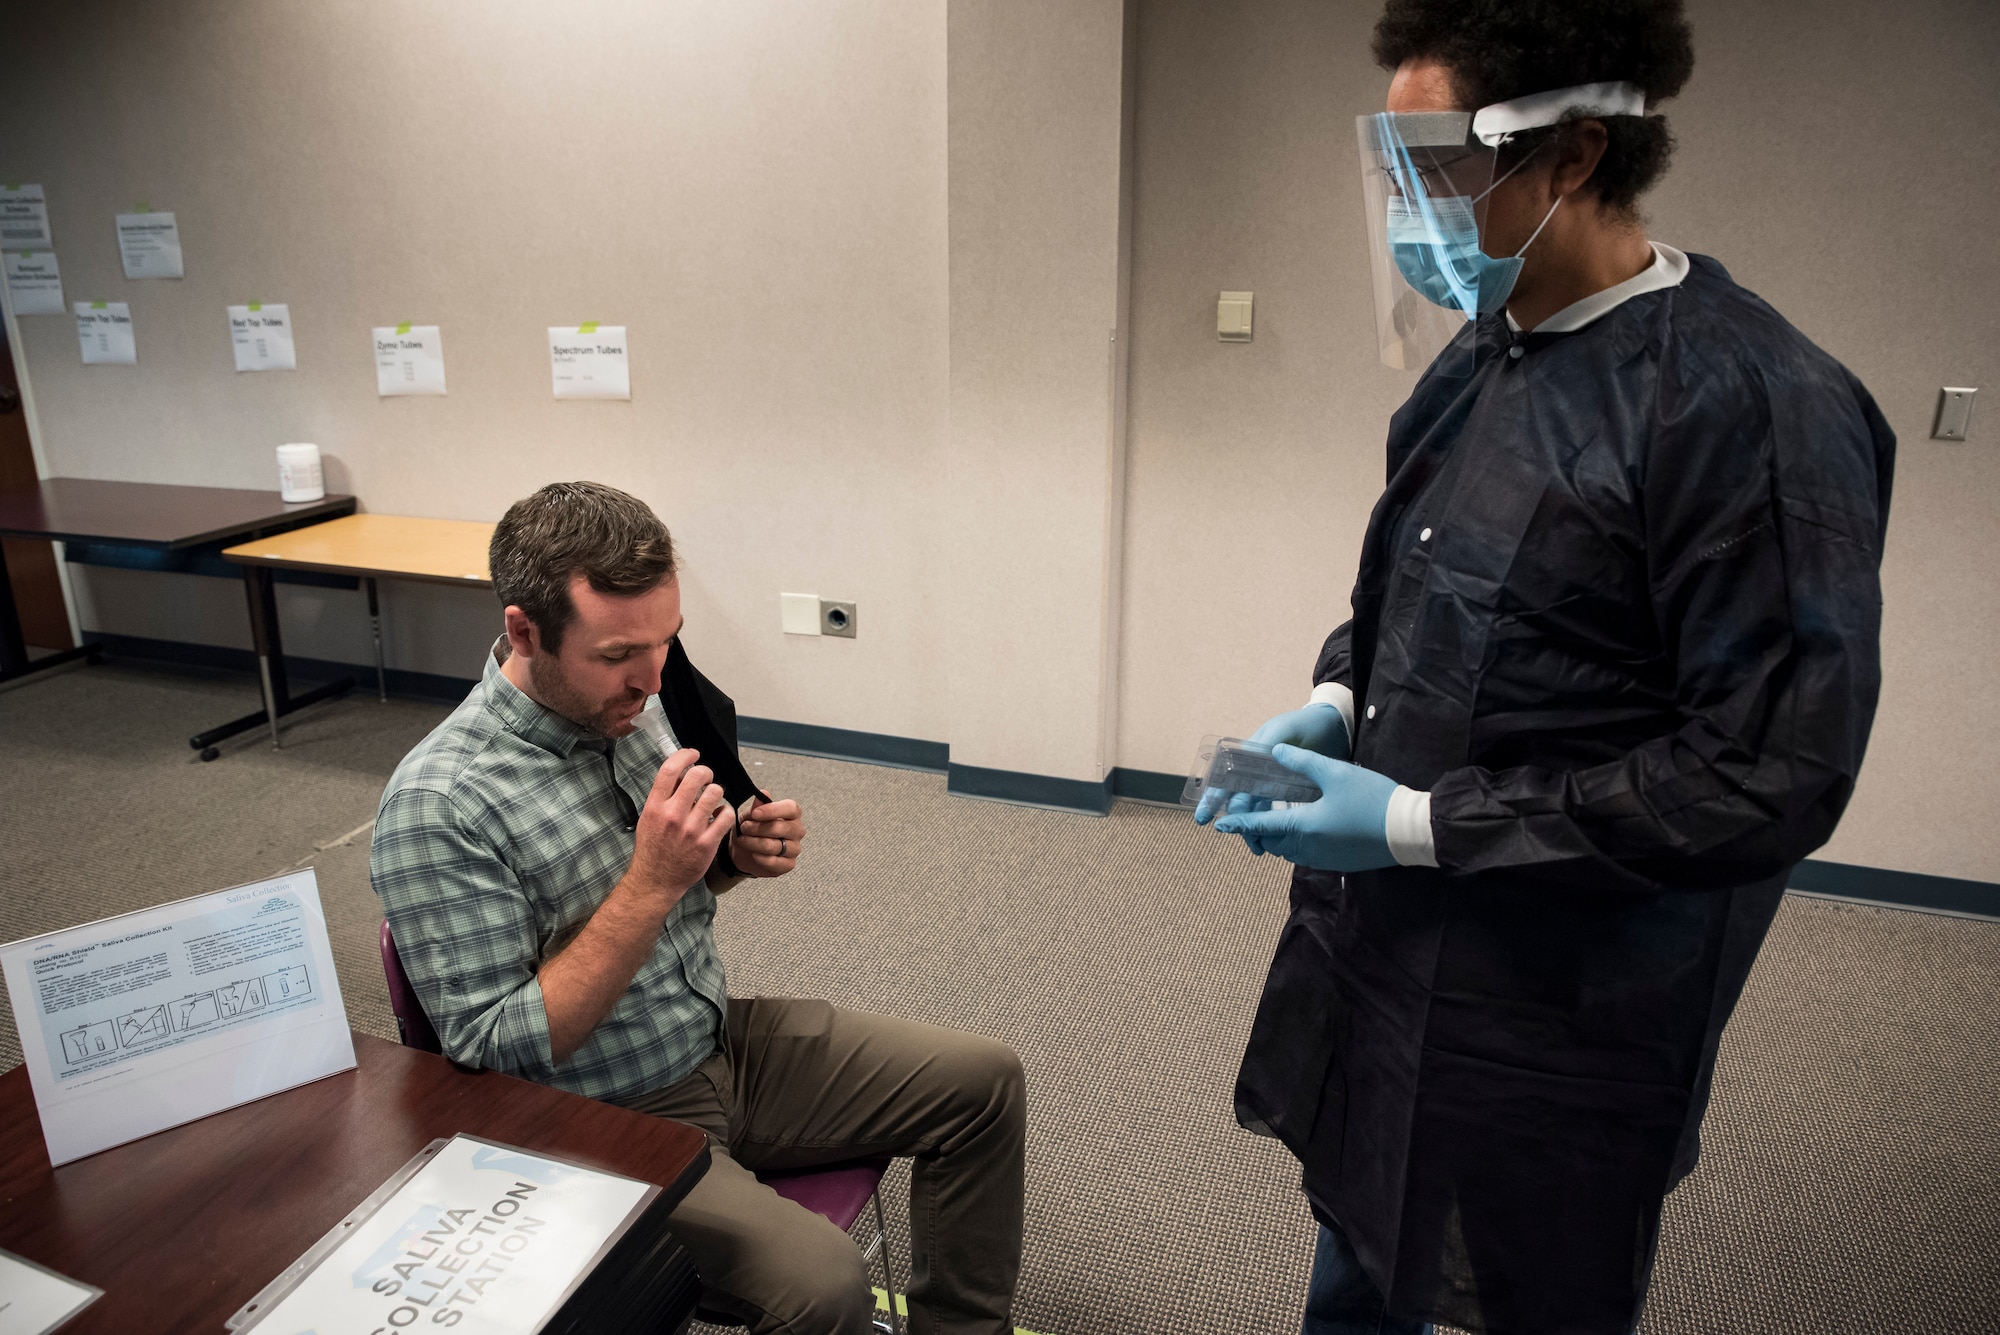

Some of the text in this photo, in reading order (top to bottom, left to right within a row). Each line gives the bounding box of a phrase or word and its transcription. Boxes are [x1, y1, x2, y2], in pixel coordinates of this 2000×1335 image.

[247, 318, 261, 328] Top
[262, 318, 283, 327] Tubes
[400, 340, 423, 349] Tubes
[553, 345, 622, 356] Spectrum Tubes
[226, 881, 294, 904] Saliva Collection
[33, 952, 70, 965] DNA/RNA
[102, 938, 124, 947] Saliva
[126, 929, 161, 941] Collection
[36, 959, 84, 975] Quick Protocol
[372, 1206, 476, 1297] SALIVA
[432, 1215, 547, 1328] STATION
